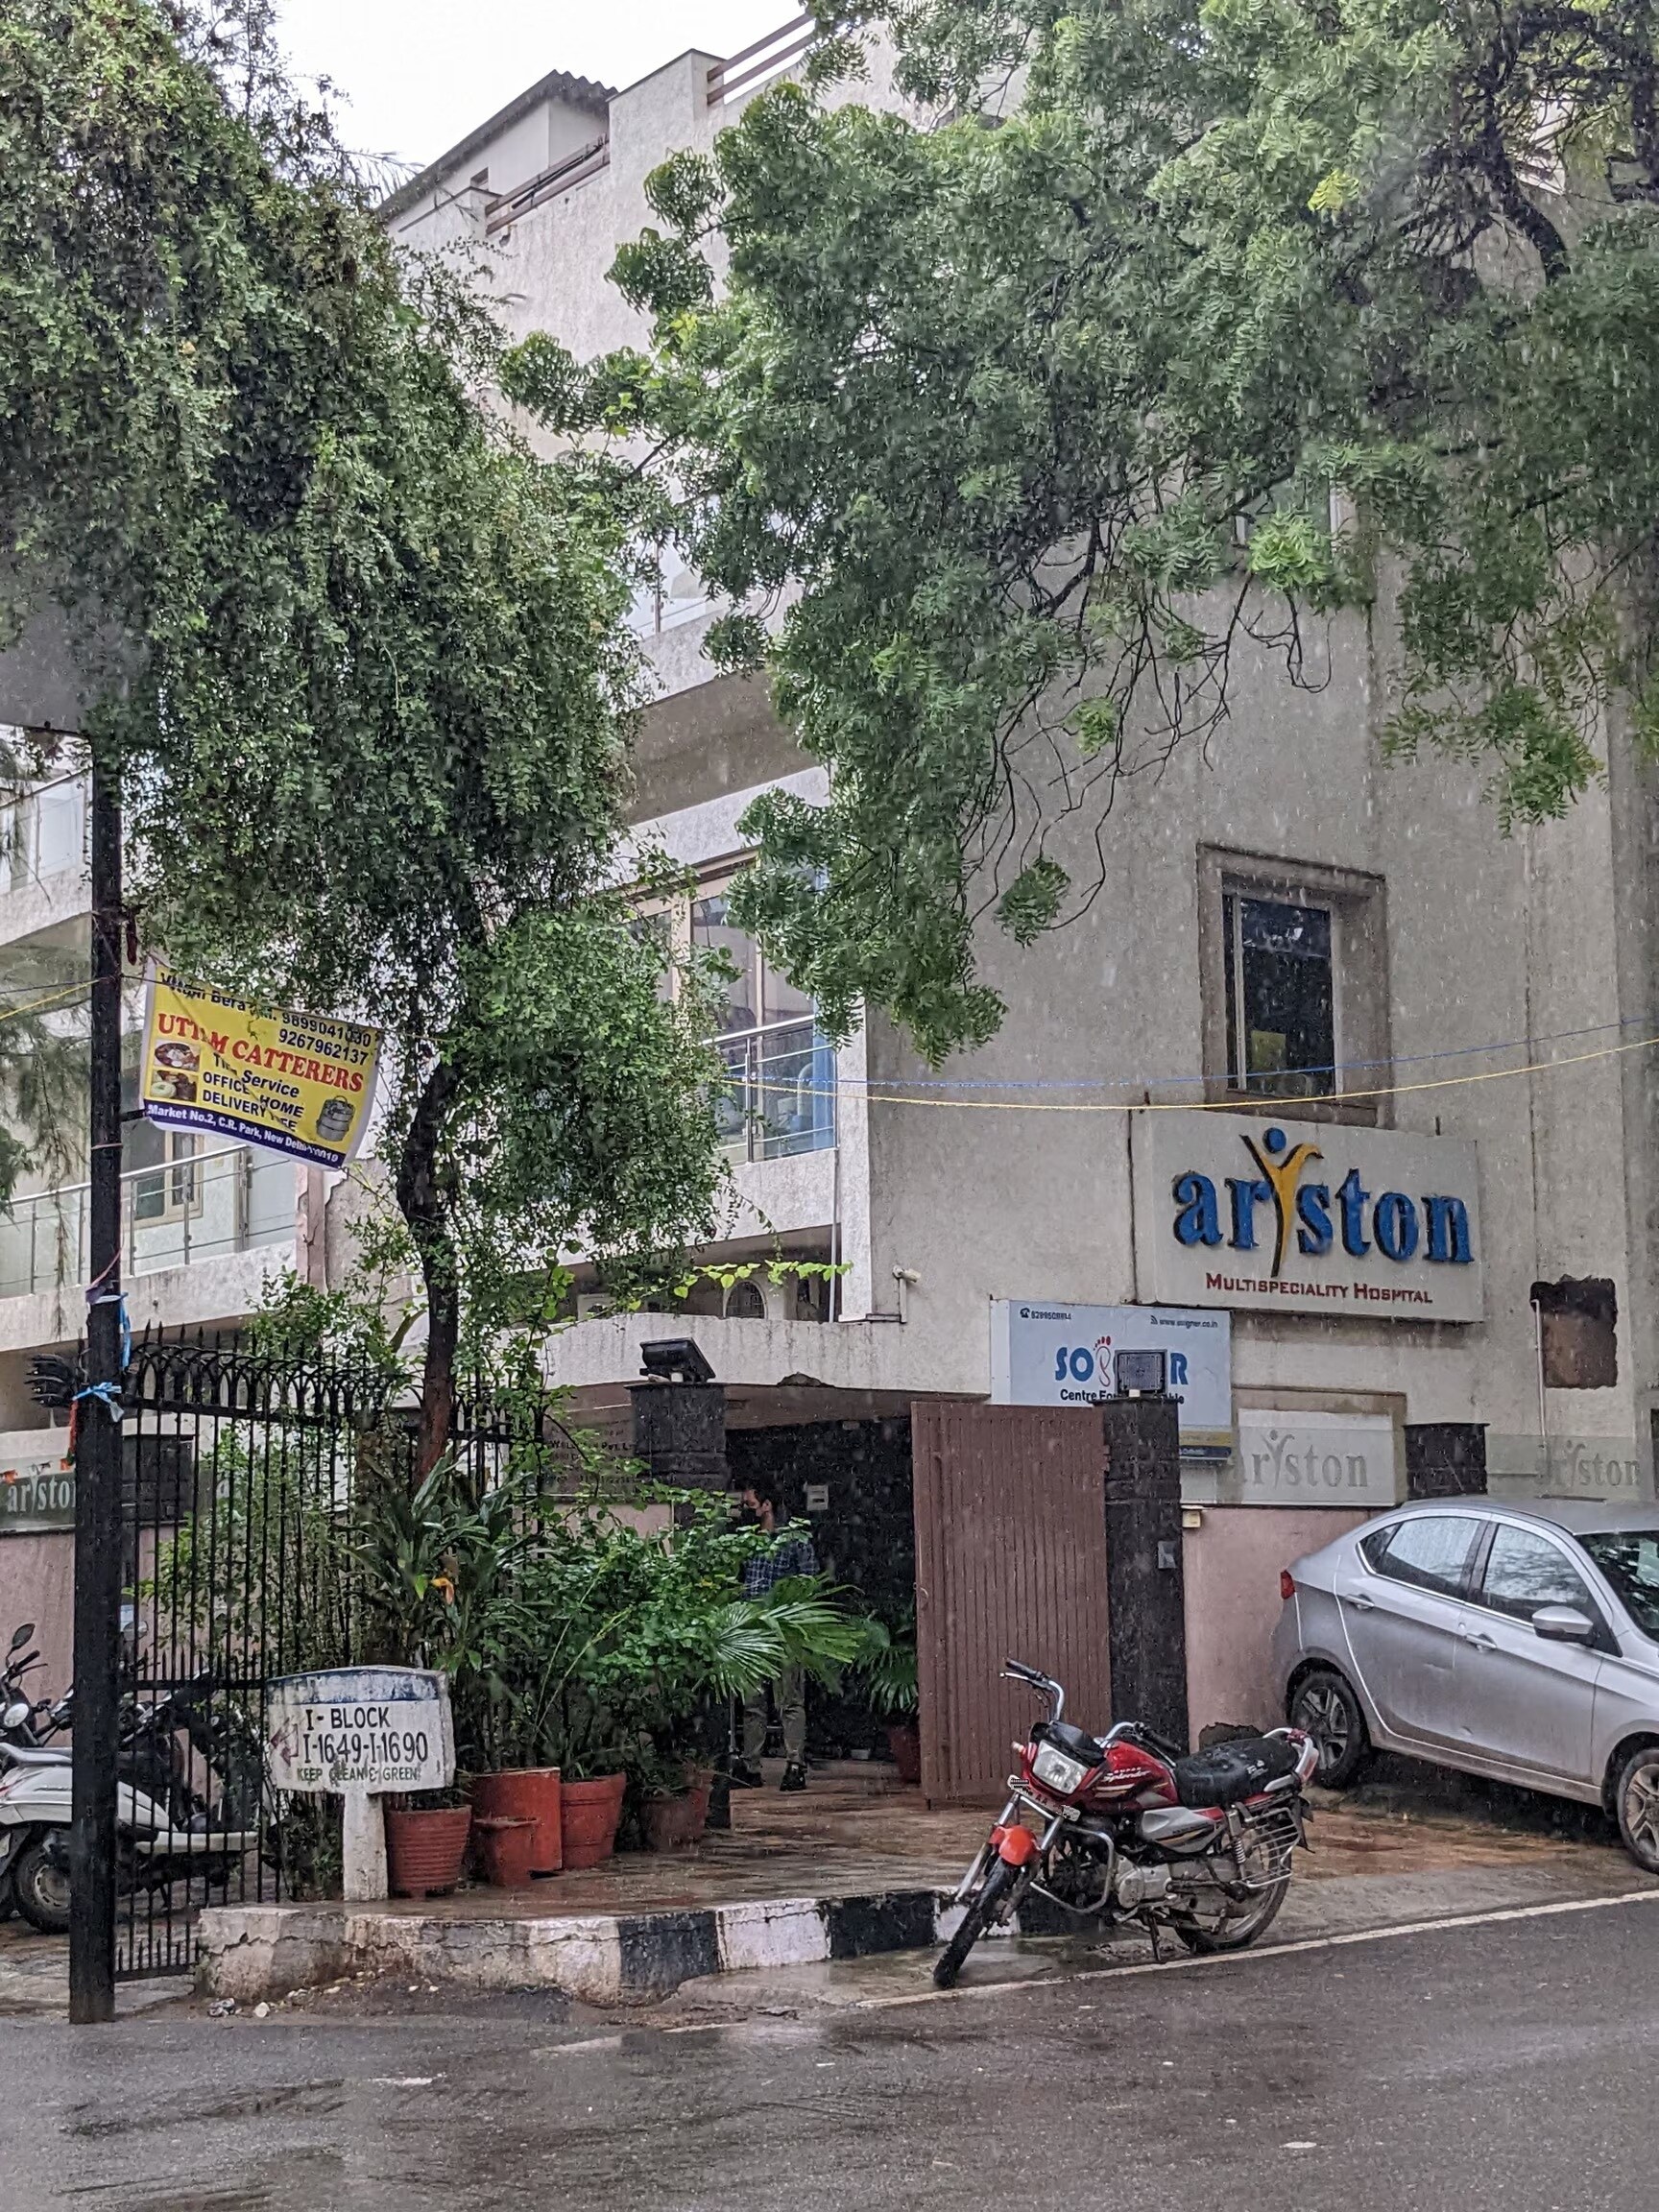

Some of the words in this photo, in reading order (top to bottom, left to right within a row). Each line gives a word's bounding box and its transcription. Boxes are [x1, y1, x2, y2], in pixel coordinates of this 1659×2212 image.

[278, 1028, 369, 1066] 9267962137
[232, 1037, 364, 1093] CATTERERS
[203, 1071, 251, 1095] OFFICE
[259, 1094, 304, 1118] HOME
[241, 1070, 301, 1098] Service
[203, 1089, 267, 1118] DELIVERY
[147, 1104, 188, 1120] Market
[264, 1130, 284, 1144] New
[1060, 1389, 1096, 1402] Centre
[297, 1767, 323, 1782] KEEP
[329, 1767, 365, 1782] CLEAN
[382, 1767, 418, 1782] GREEN
